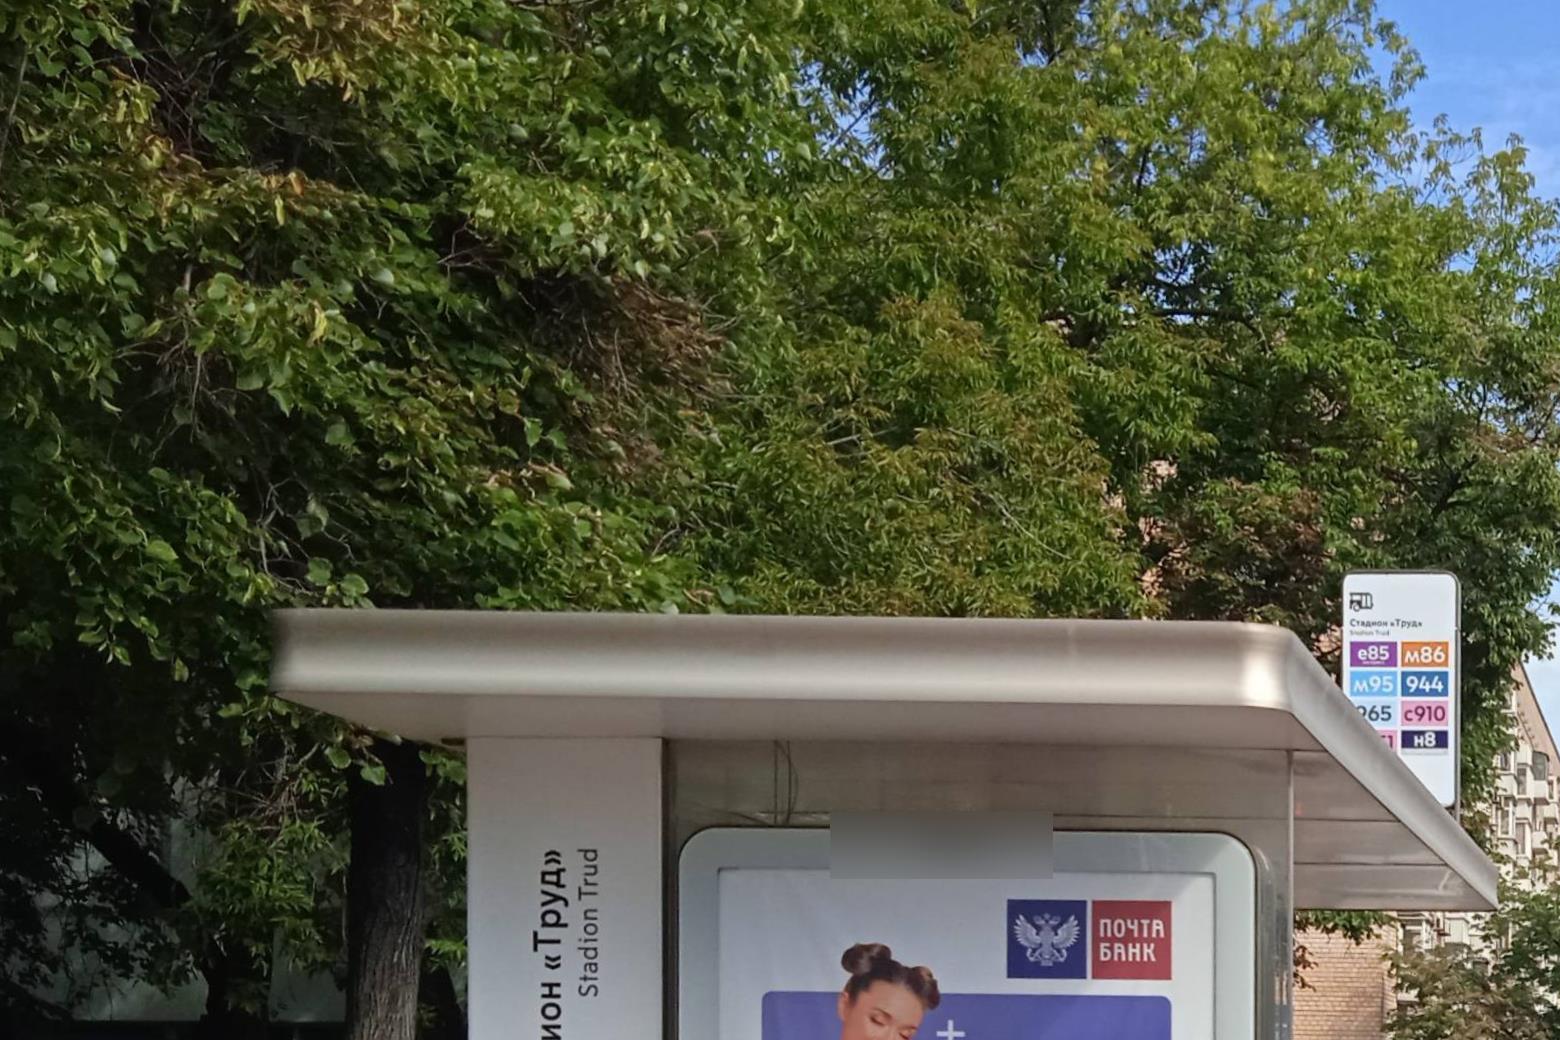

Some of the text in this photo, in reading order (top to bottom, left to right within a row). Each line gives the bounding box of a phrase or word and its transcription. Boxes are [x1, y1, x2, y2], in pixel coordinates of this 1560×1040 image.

[1350, 618, 1388, 627] Стадион
[1406, 676, 1444, 693] 944
[533, 850, 568, 970] «Труд»
[577, 849, 598, 997] Stadion Trud
[1099, 918, 1165, 938] ПОЧТА
[1099, 942, 1157, 962] БАНК
